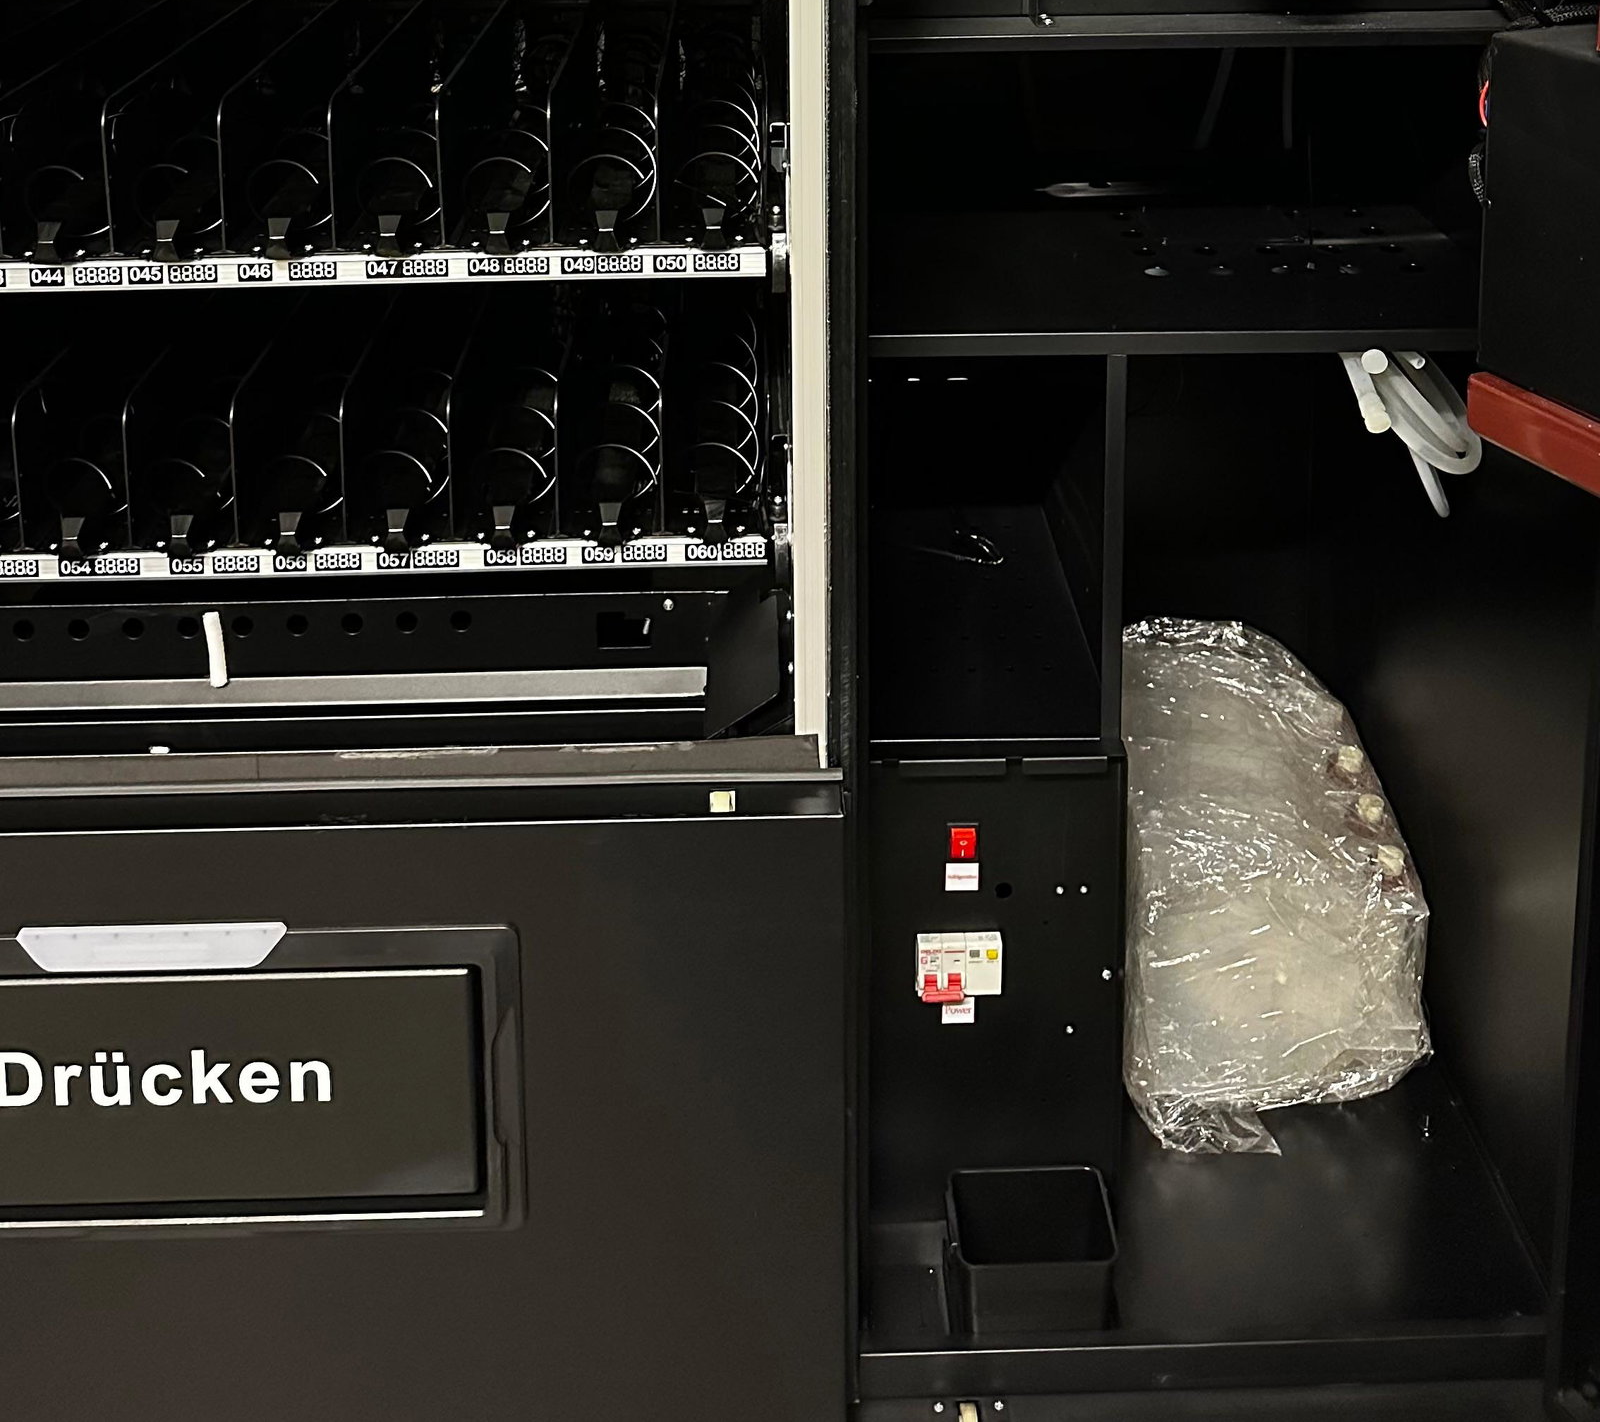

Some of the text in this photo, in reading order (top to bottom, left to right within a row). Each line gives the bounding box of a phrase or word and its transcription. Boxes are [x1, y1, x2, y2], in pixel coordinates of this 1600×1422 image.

[367, 261, 398, 275] 047
[469, 258, 500, 273] 048
[564, 257, 595, 271] 049
[656, 256, 686, 270] 050
[31, 269, 63, 283] 044
[129, 267, 162, 282] 045
[240, 264, 271, 278] 046
[486, 550, 517, 564] 058
[584, 546, 613, 561] 059
[688, 545, 717, 559] 060
[172, 559, 203, 573] 055
[275, 556, 306, 570] 056
[379, 553, 410, 567] 057
[60, 561, 92, 574] 054
[945, 1006, 972, 1014] Power
[0, 1049, 333, 1107] Drücken
